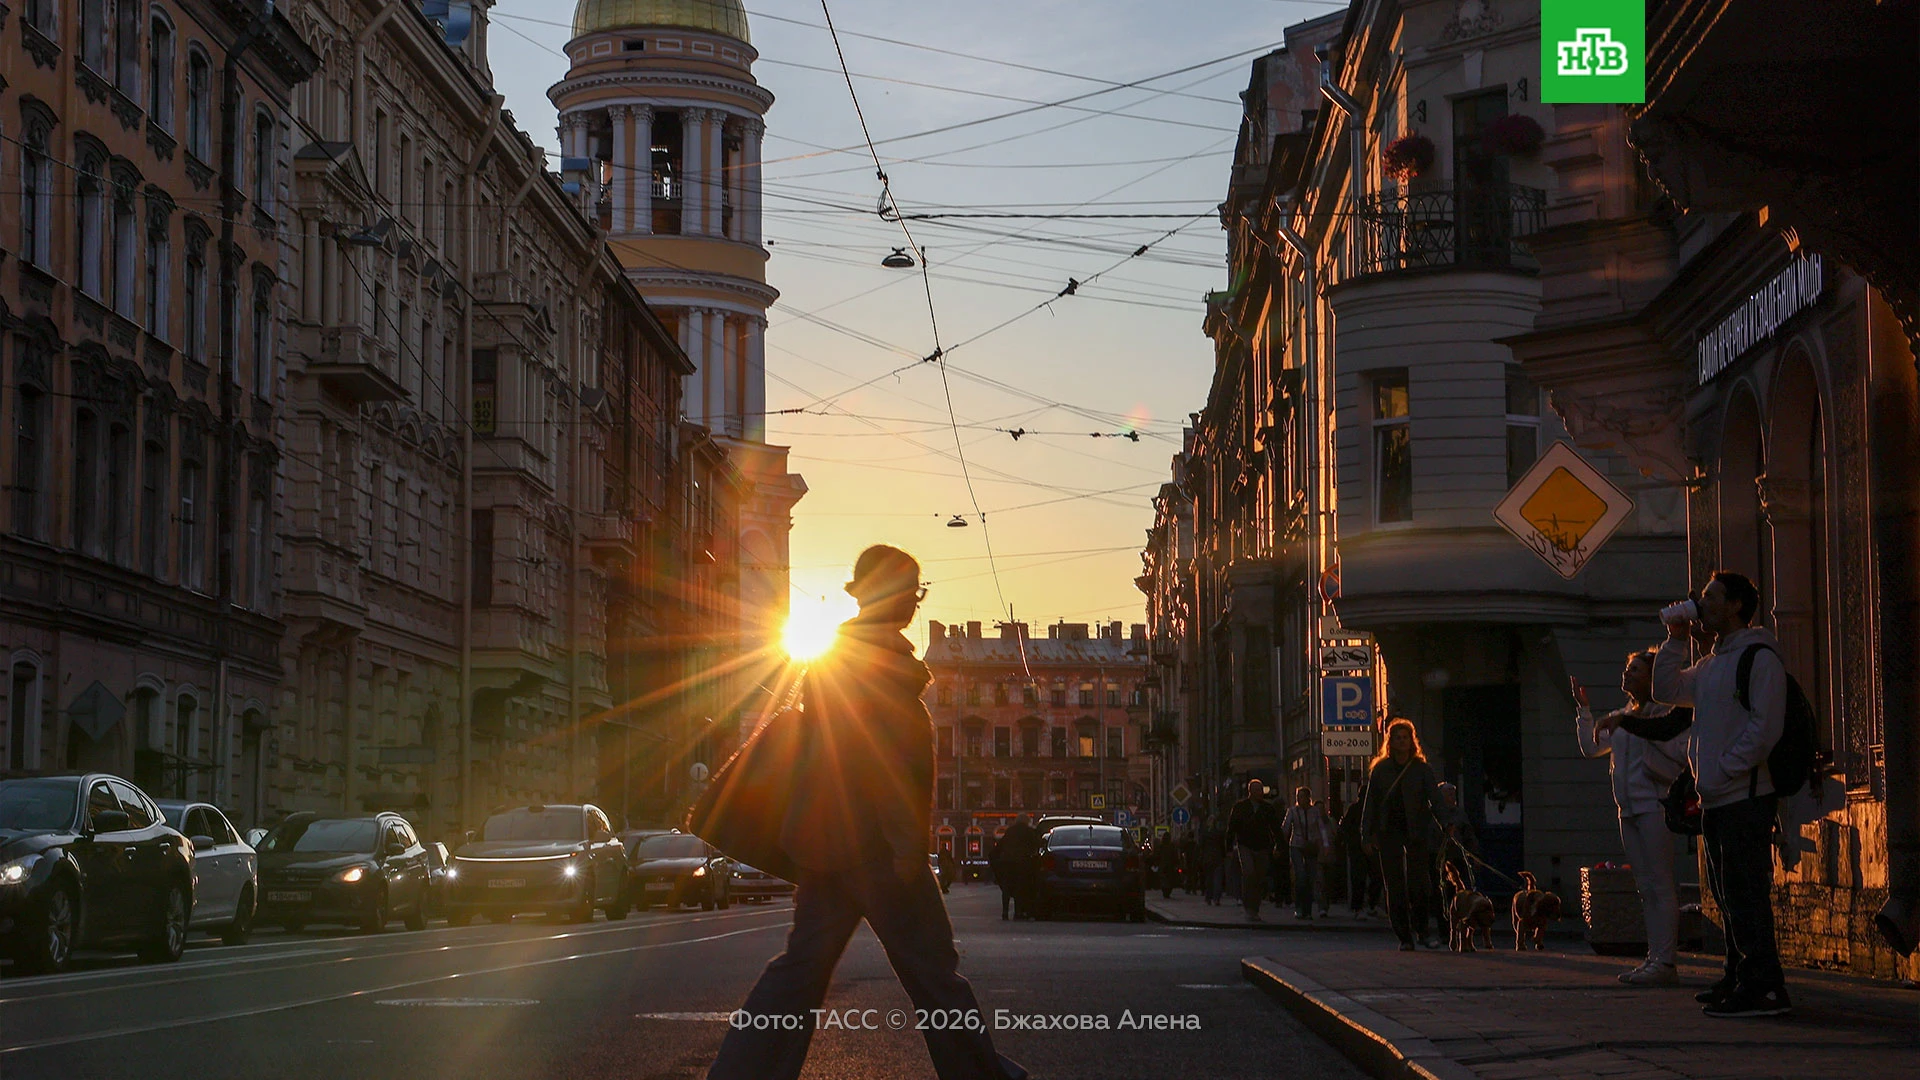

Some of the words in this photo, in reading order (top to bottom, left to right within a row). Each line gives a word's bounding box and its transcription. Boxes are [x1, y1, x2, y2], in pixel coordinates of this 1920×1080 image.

[1698, 328, 1718, 386] САЛОН
[1797, 252, 1822, 310] МОДЫ
[1336, 682, 1363, 721] P
[1326, 738, 1370, 747] 8.00-20.00
